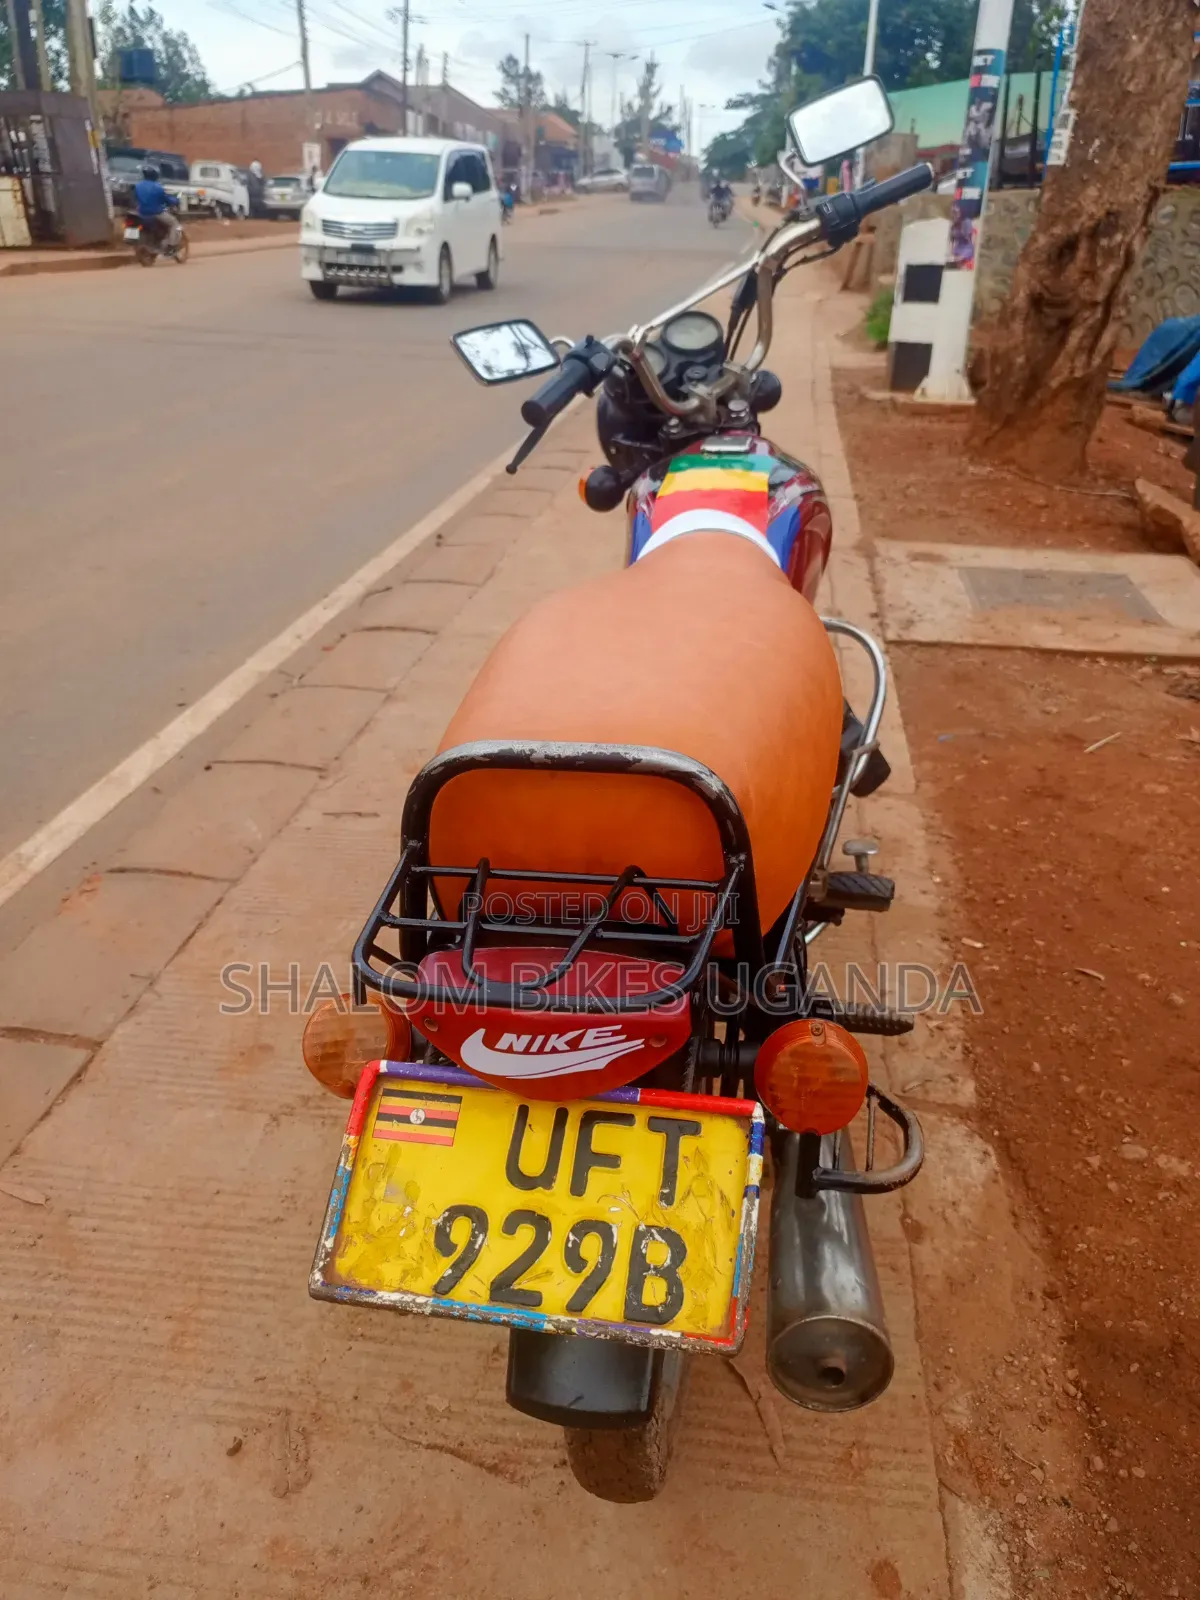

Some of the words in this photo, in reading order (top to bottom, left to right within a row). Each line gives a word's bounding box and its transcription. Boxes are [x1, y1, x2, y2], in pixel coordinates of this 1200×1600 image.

[494, 1024, 628, 1053] NIKE
[505, 1104, 702, 1208] UFT
[432, 1204, 688, 1325] 929B
